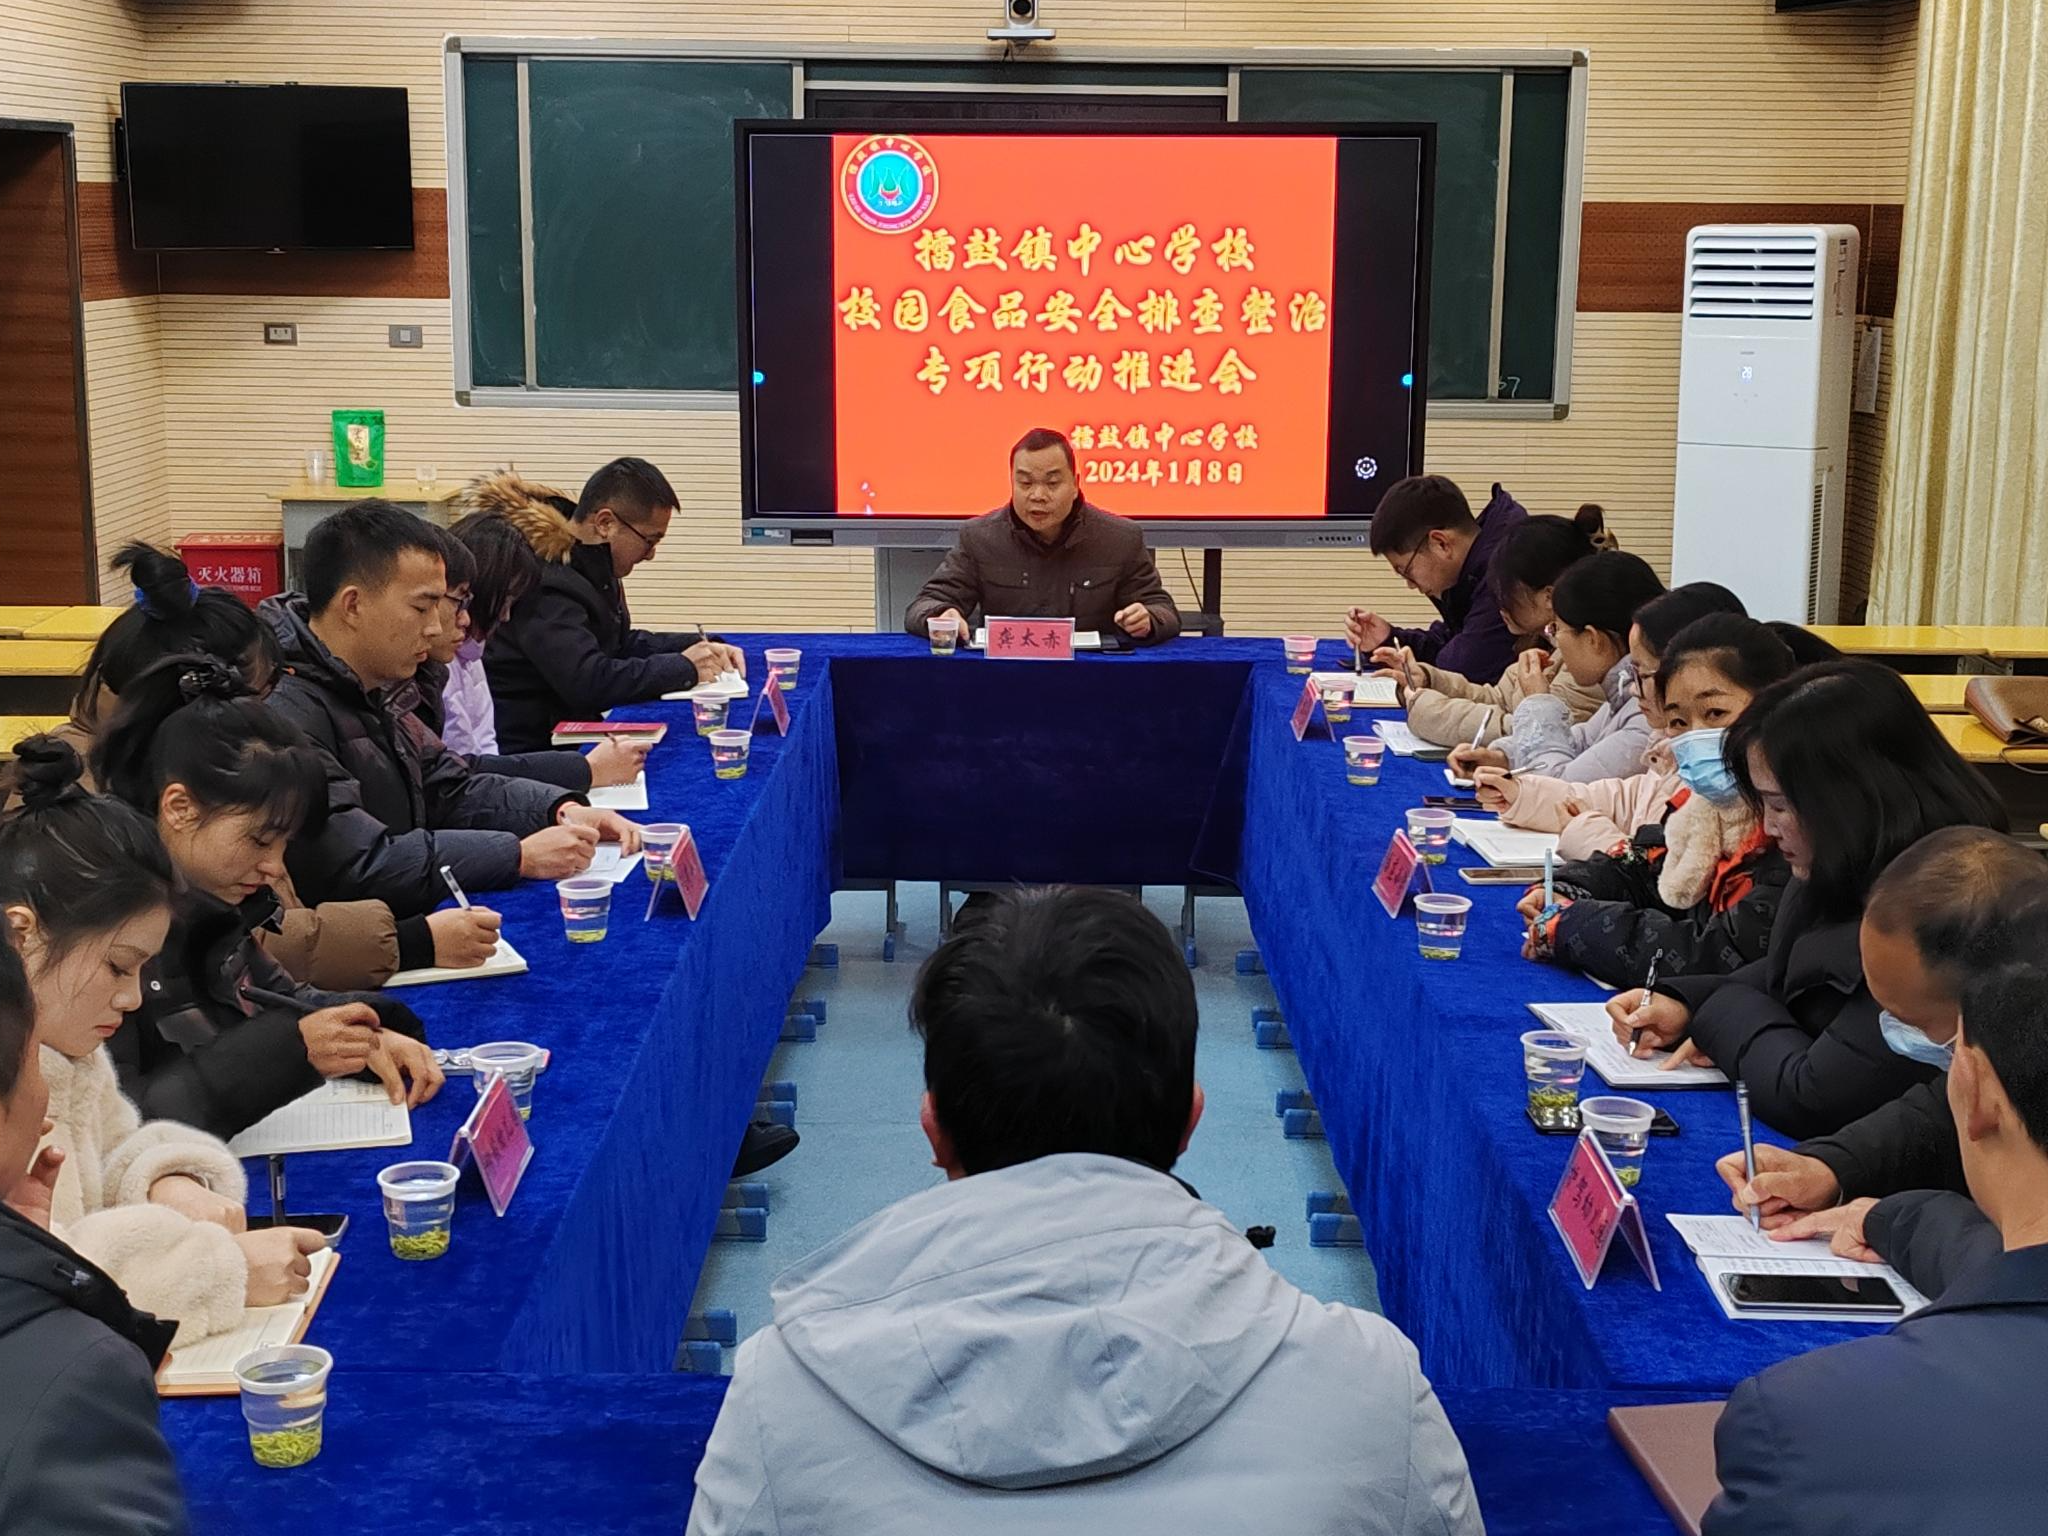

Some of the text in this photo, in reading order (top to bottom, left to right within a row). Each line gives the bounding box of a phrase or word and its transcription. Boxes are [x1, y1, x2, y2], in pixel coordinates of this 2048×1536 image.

[914, 223, 1255, 276] 擂鼓镇中心学校
[838, 286, 1326, 335] 校园食品安全排查整治
[916, 346, 1257, 395] 专项行动推进会
[1071, 422, 1258, 452] 擂鼓镇中心学校
[1085, 458, 1242, 487] 2024年1月8日
[197, 565, 262, 585] 灭火器箱
